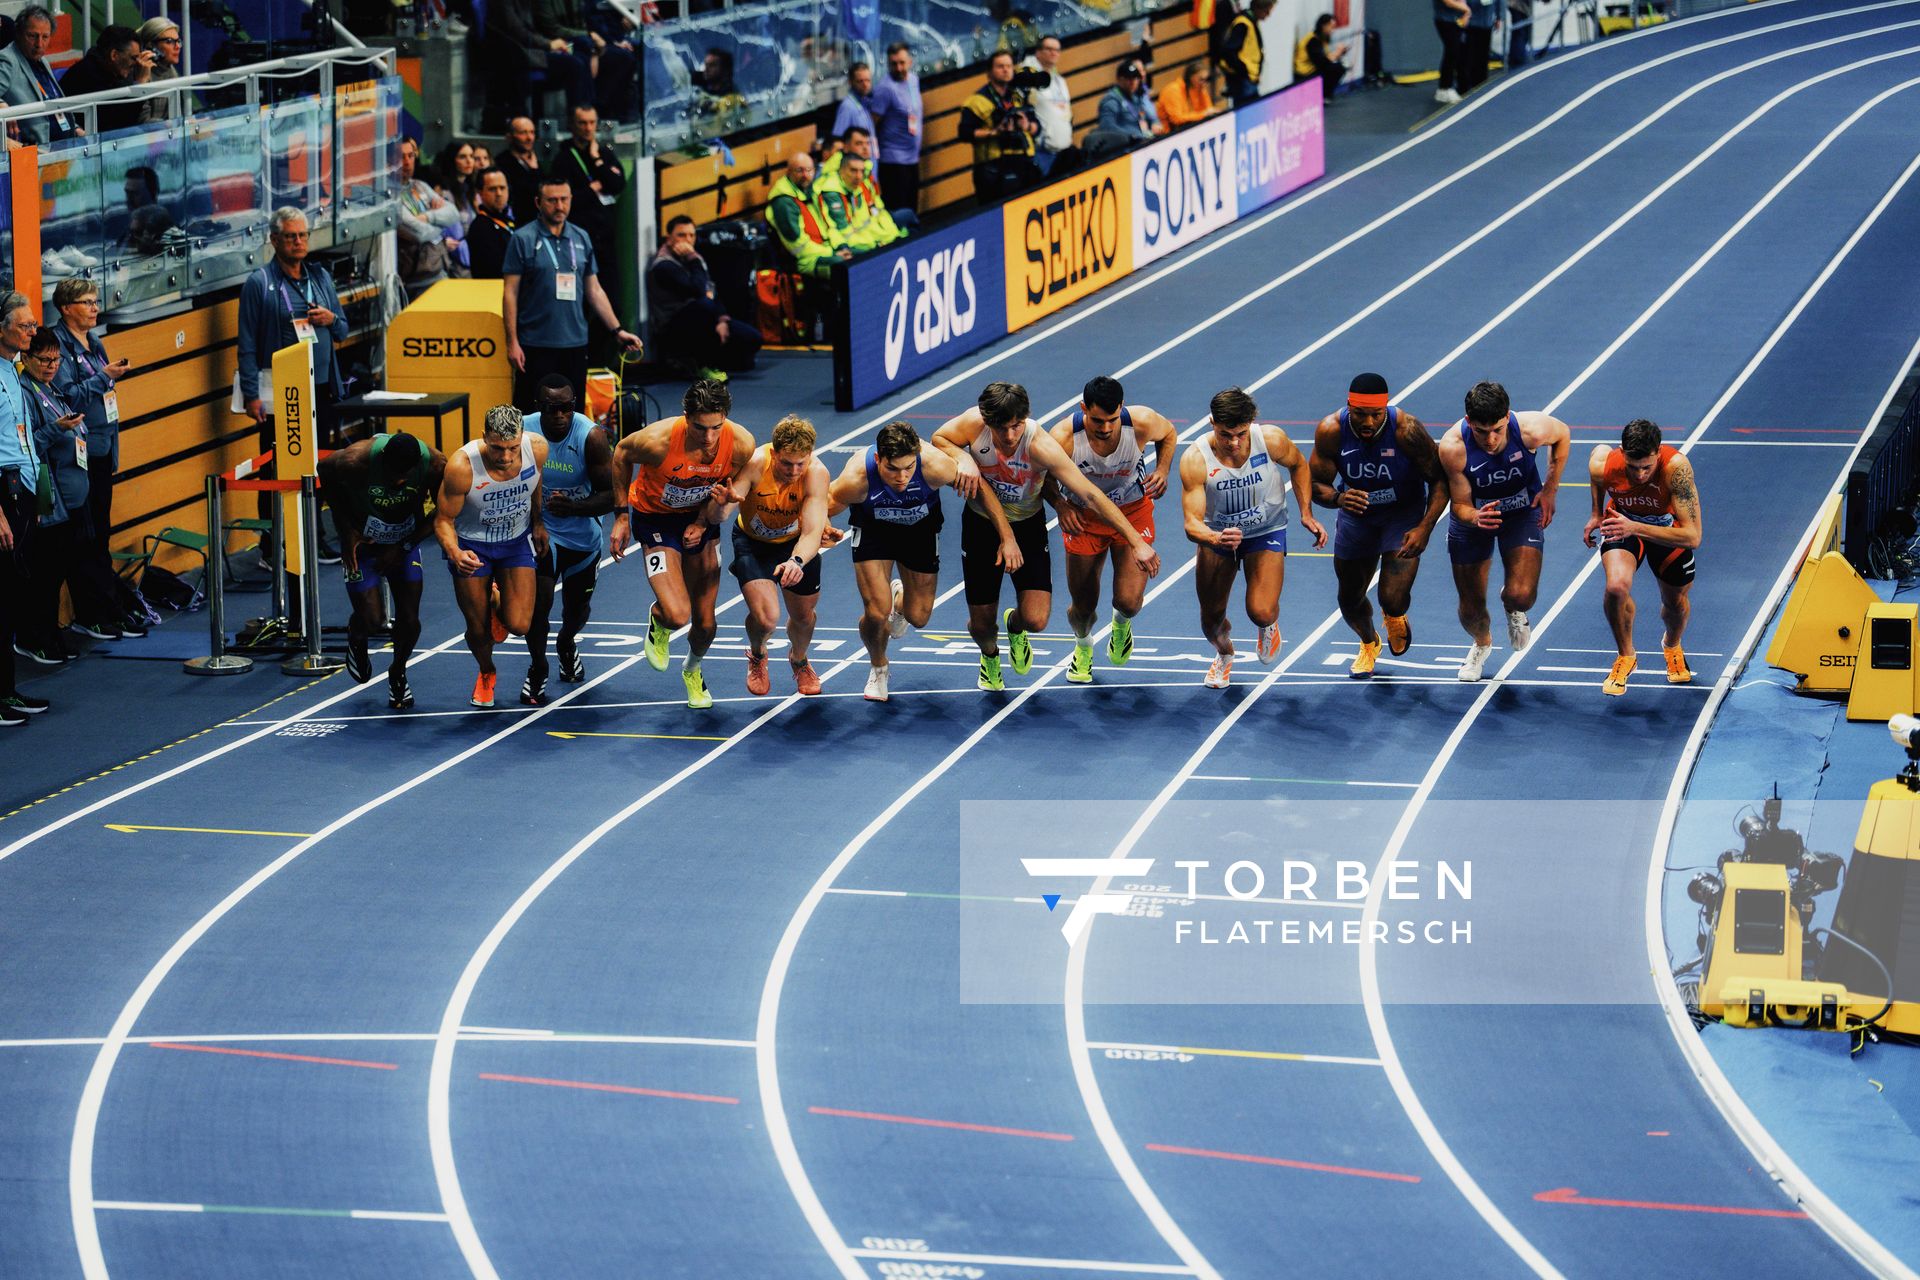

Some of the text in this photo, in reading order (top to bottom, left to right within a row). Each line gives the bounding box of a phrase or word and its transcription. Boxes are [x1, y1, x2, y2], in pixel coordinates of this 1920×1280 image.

[1246, 118, 1282, 190] TDK
[1144, 132, 1227, 247] SONY
[1025, 176, 1118, 306] SEIKO
[402, 337, 497, 358] SEIKO
[285, 386, 302, 456] SEIKO
[1346, 462, 1393, 481] USA
[1476, 467, 1523, 489] USA
[1216, 471, 1263, 492] CZECHIA
[482, 483, 529, 502] CZECHIA
[1617, 496, 1661, 508] SUISSE
[481, 506, 528, 524] KOPECKÝ
[496, 499, 527, 516] TDK
[889, 506, 924, 516] TDK
[1227, 506, 1262, 521] TDK
[1105, 1049, 1195, 1062] 4x200
[861, 1236, 930, 1252] 200
